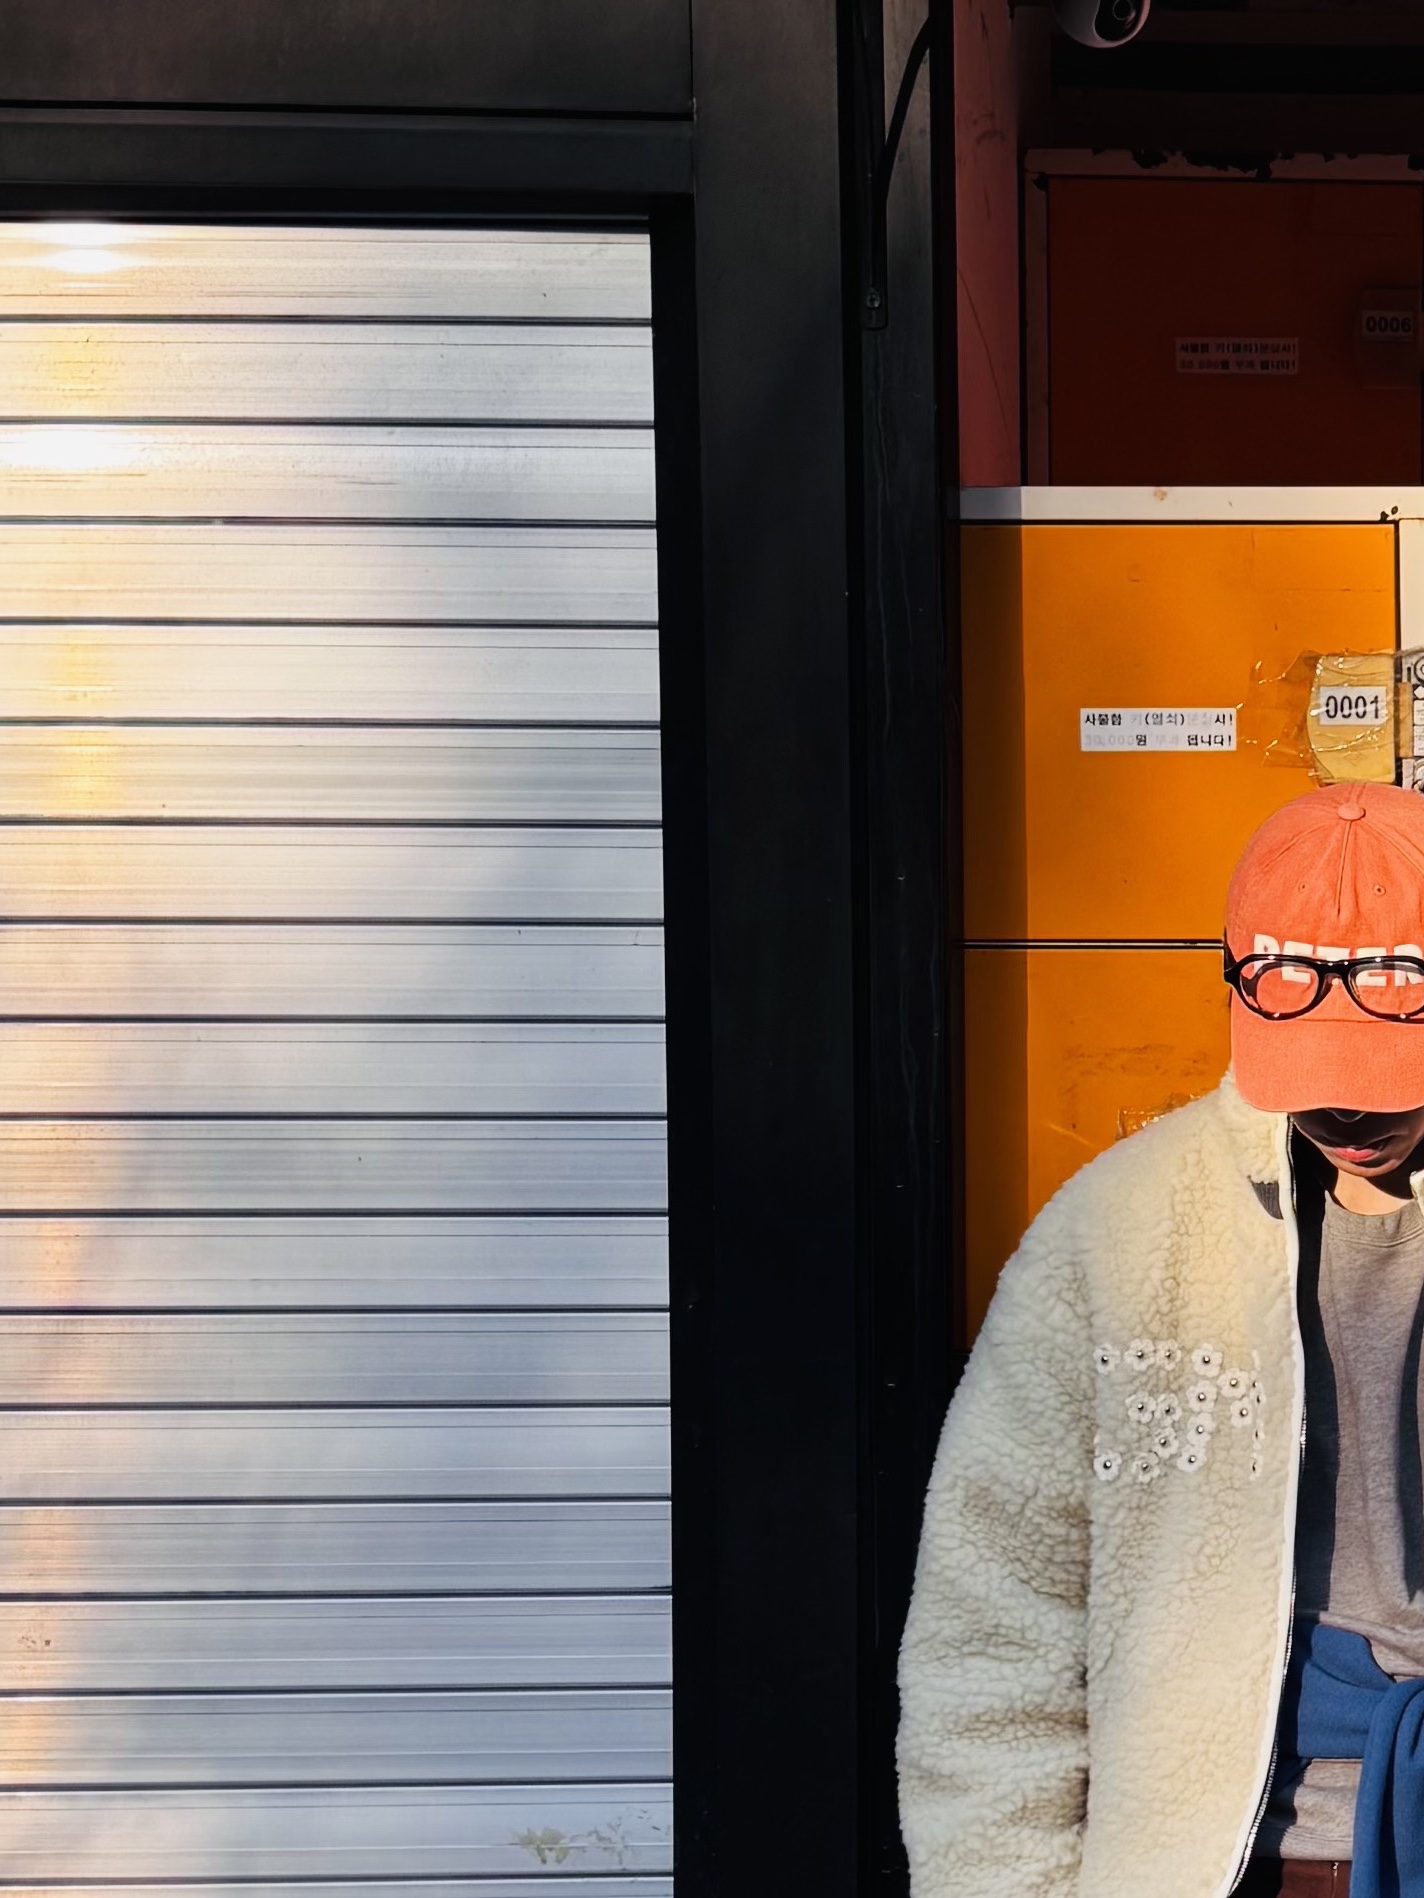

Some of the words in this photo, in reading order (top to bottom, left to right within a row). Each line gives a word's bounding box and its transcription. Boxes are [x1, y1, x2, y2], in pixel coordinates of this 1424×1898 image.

[1365, 316, 1412, 333] 0006
[1325, 694, 1380, 720] 0001
[1085, 712, 1122, 727] 사물함
[1187, 733, 1232, 747] 됩니다!
